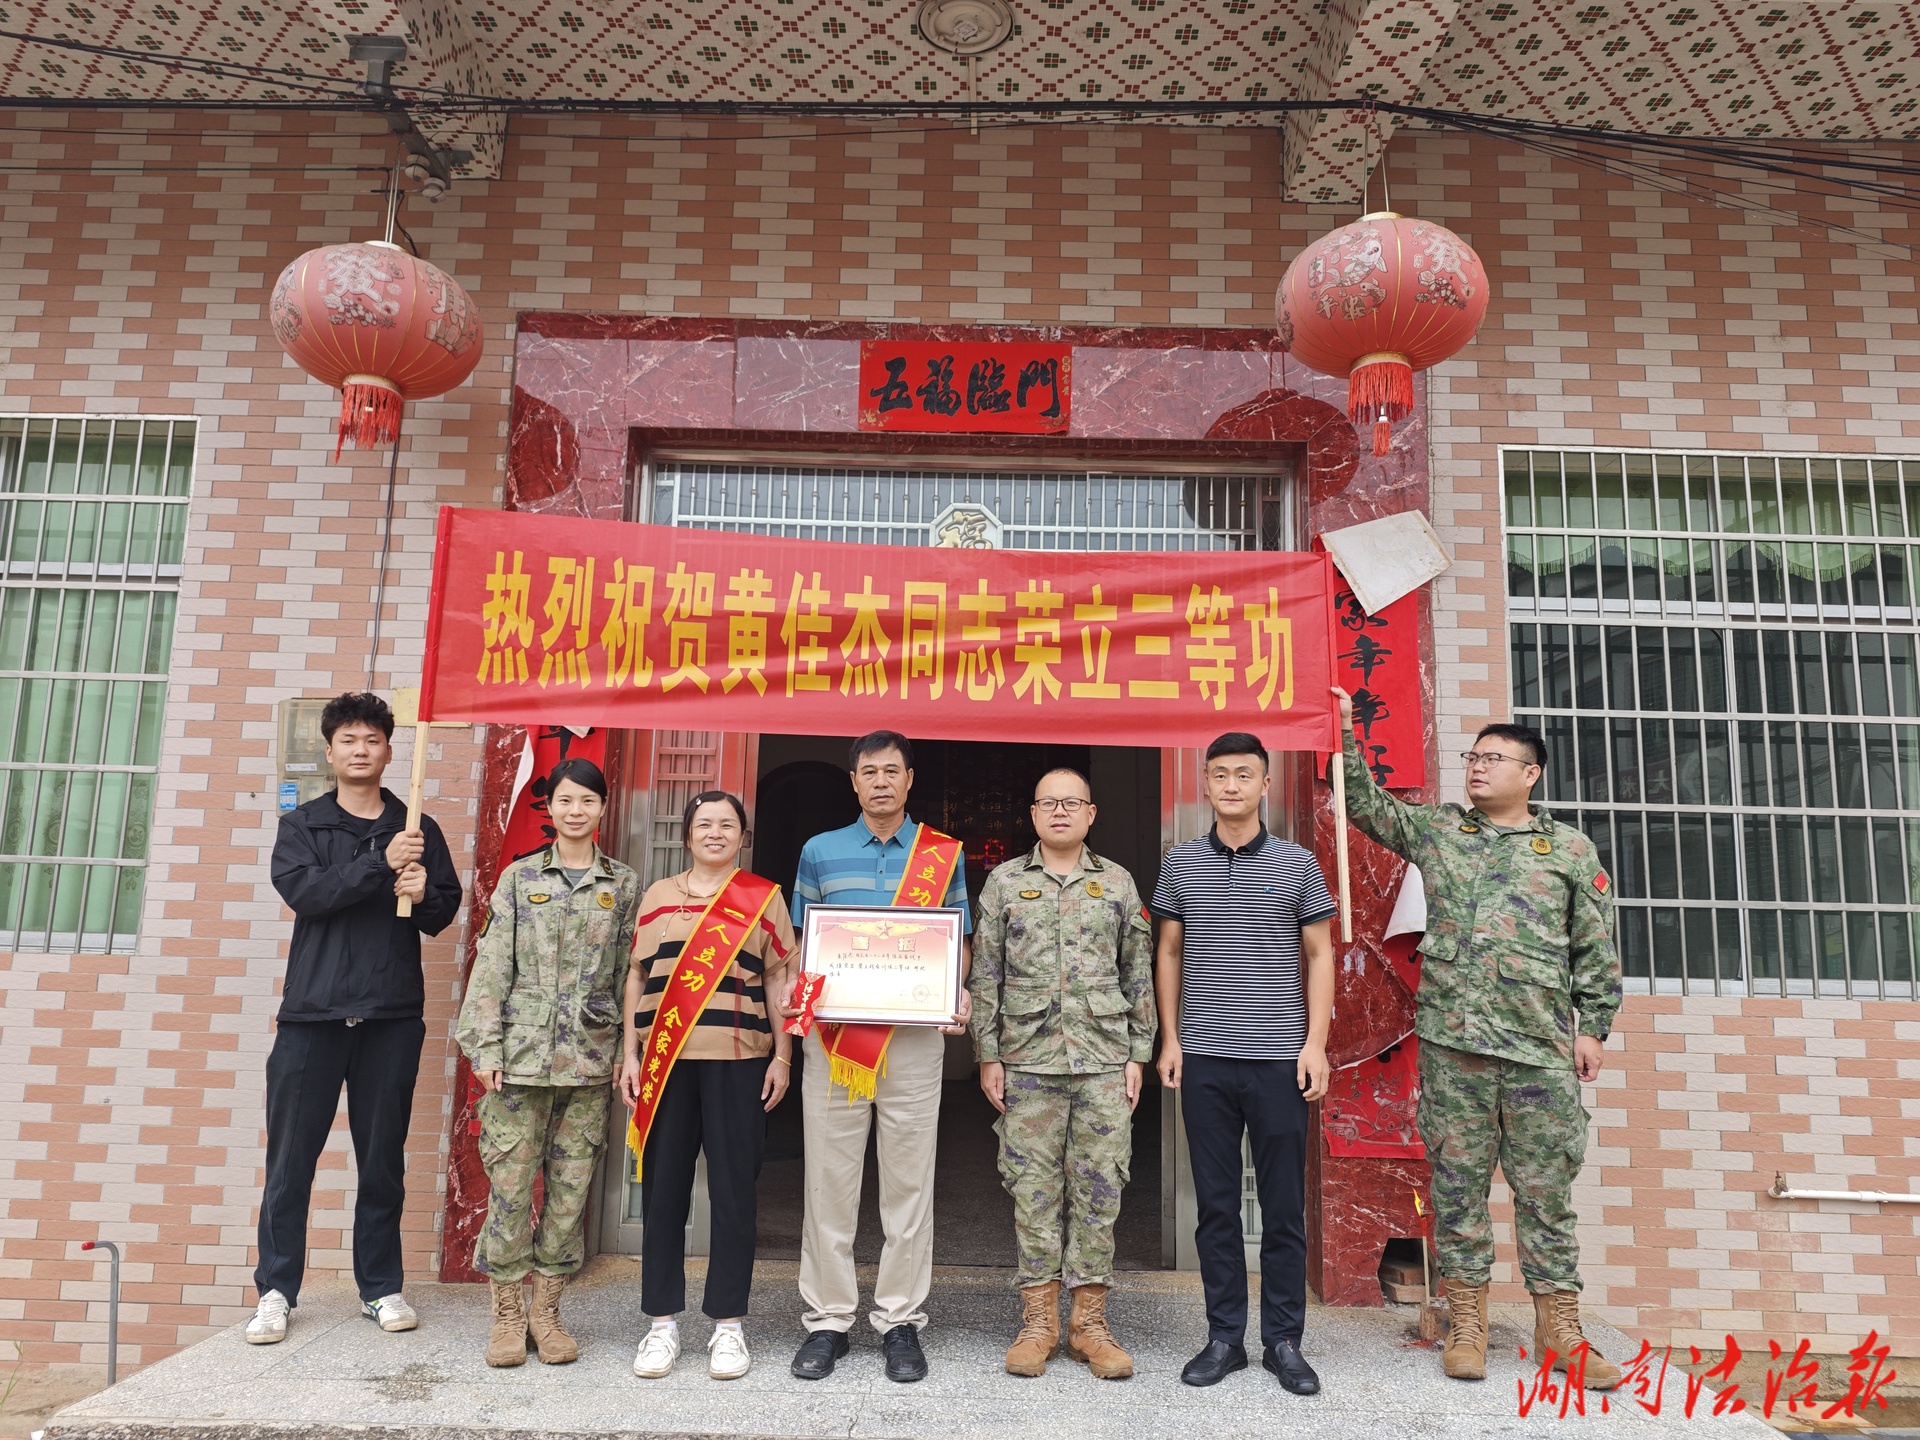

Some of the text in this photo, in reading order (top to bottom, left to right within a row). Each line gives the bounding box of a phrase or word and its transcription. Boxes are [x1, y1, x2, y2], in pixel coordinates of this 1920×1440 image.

[476, 549, 1295, 712] 热烈祝贺黄佳杰同志荣立三等功
[908, 829, 952, 907] 一人立功
[680, 906, 746, 993] 一人立功
